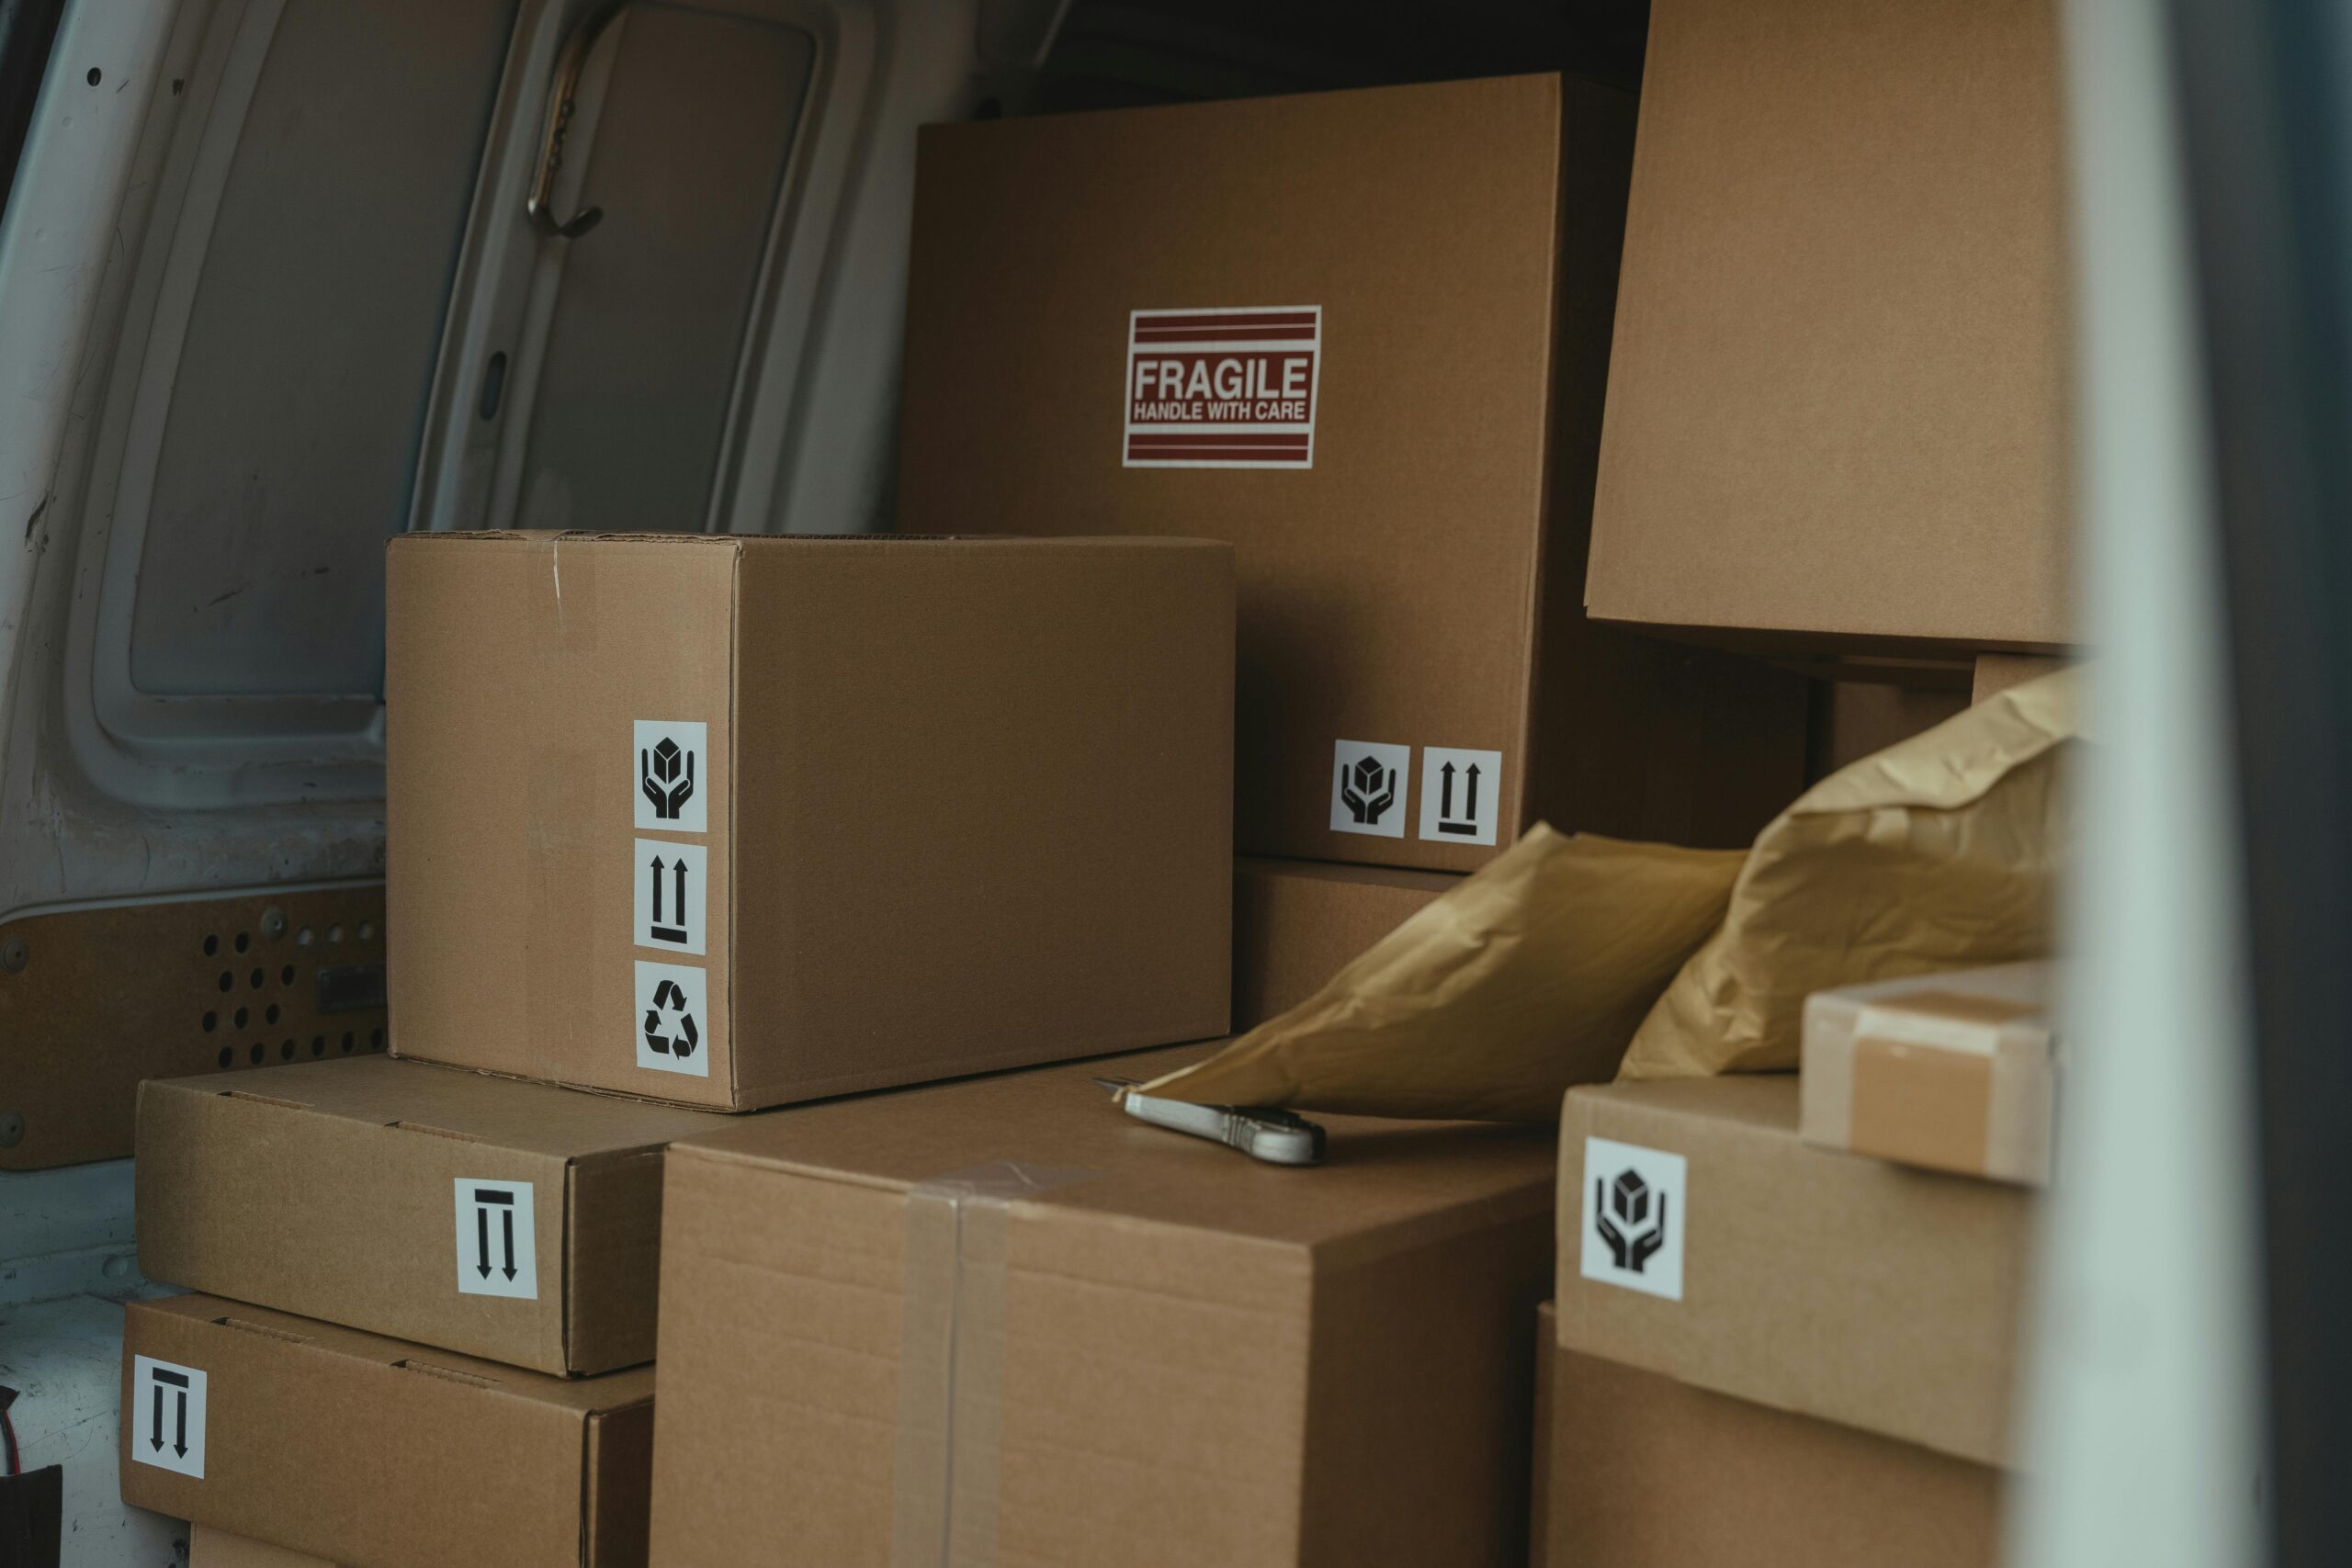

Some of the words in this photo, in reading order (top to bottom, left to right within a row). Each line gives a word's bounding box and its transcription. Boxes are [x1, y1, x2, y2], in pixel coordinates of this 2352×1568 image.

[1135, 358, 1308, 400] FRAGILE
[1134, 401, 1204, 421] HANDLE
[1207, 401, 1250, 421] WITH
[1254, 400, 1306, 421] CARE
